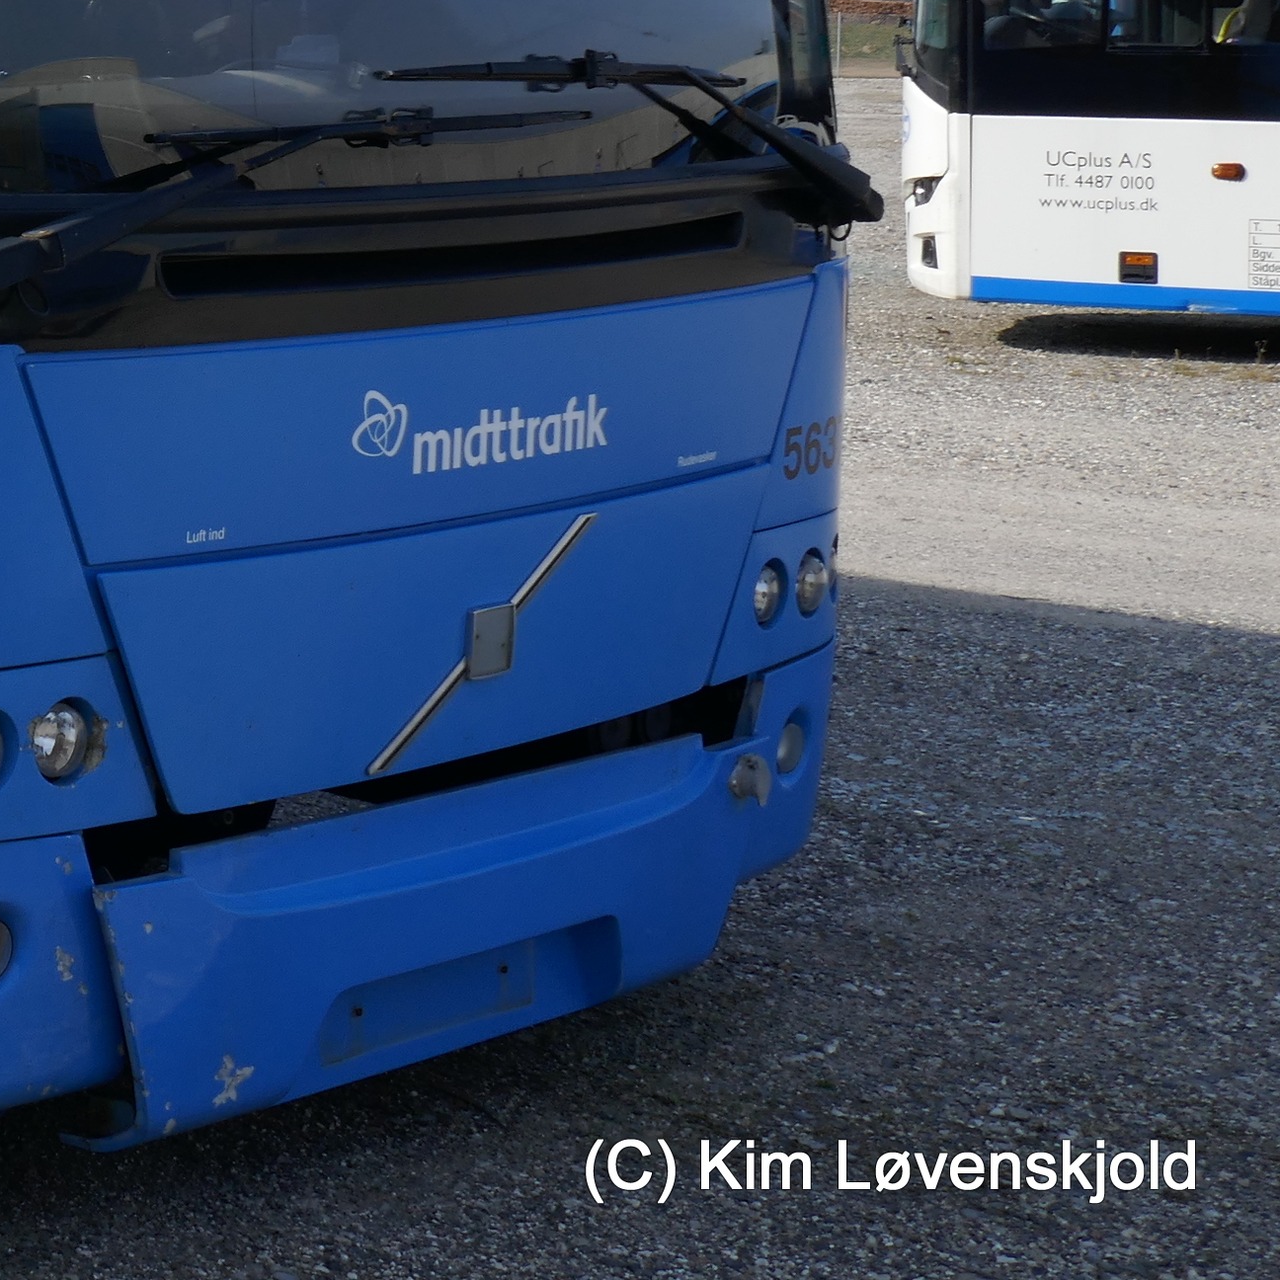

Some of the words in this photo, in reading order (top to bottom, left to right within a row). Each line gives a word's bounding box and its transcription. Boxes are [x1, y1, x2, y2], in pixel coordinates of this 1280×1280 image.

[1046, 150, 1112, 171] UCplus
[1118, 152, 1152, 169] A/S
[1043, 173, 1069, 187] Tlf.
[1074, 174, 1113, 189] 4487
[1120, 175, 1155, 190] 0100
[1038, 196, 1158, 213] www.ucplus.dk
[1253, 222, 1262, 231] T.
[1252, 236, 1262, 245] L.
[1252, 249, 1274, 261] Bgv.
[413, 394, 608, 475] midttrafik
[783, 415, 839, 480] 563
[186, 529, 206, 544] Luft
[209, 527, 225, 540] ind
